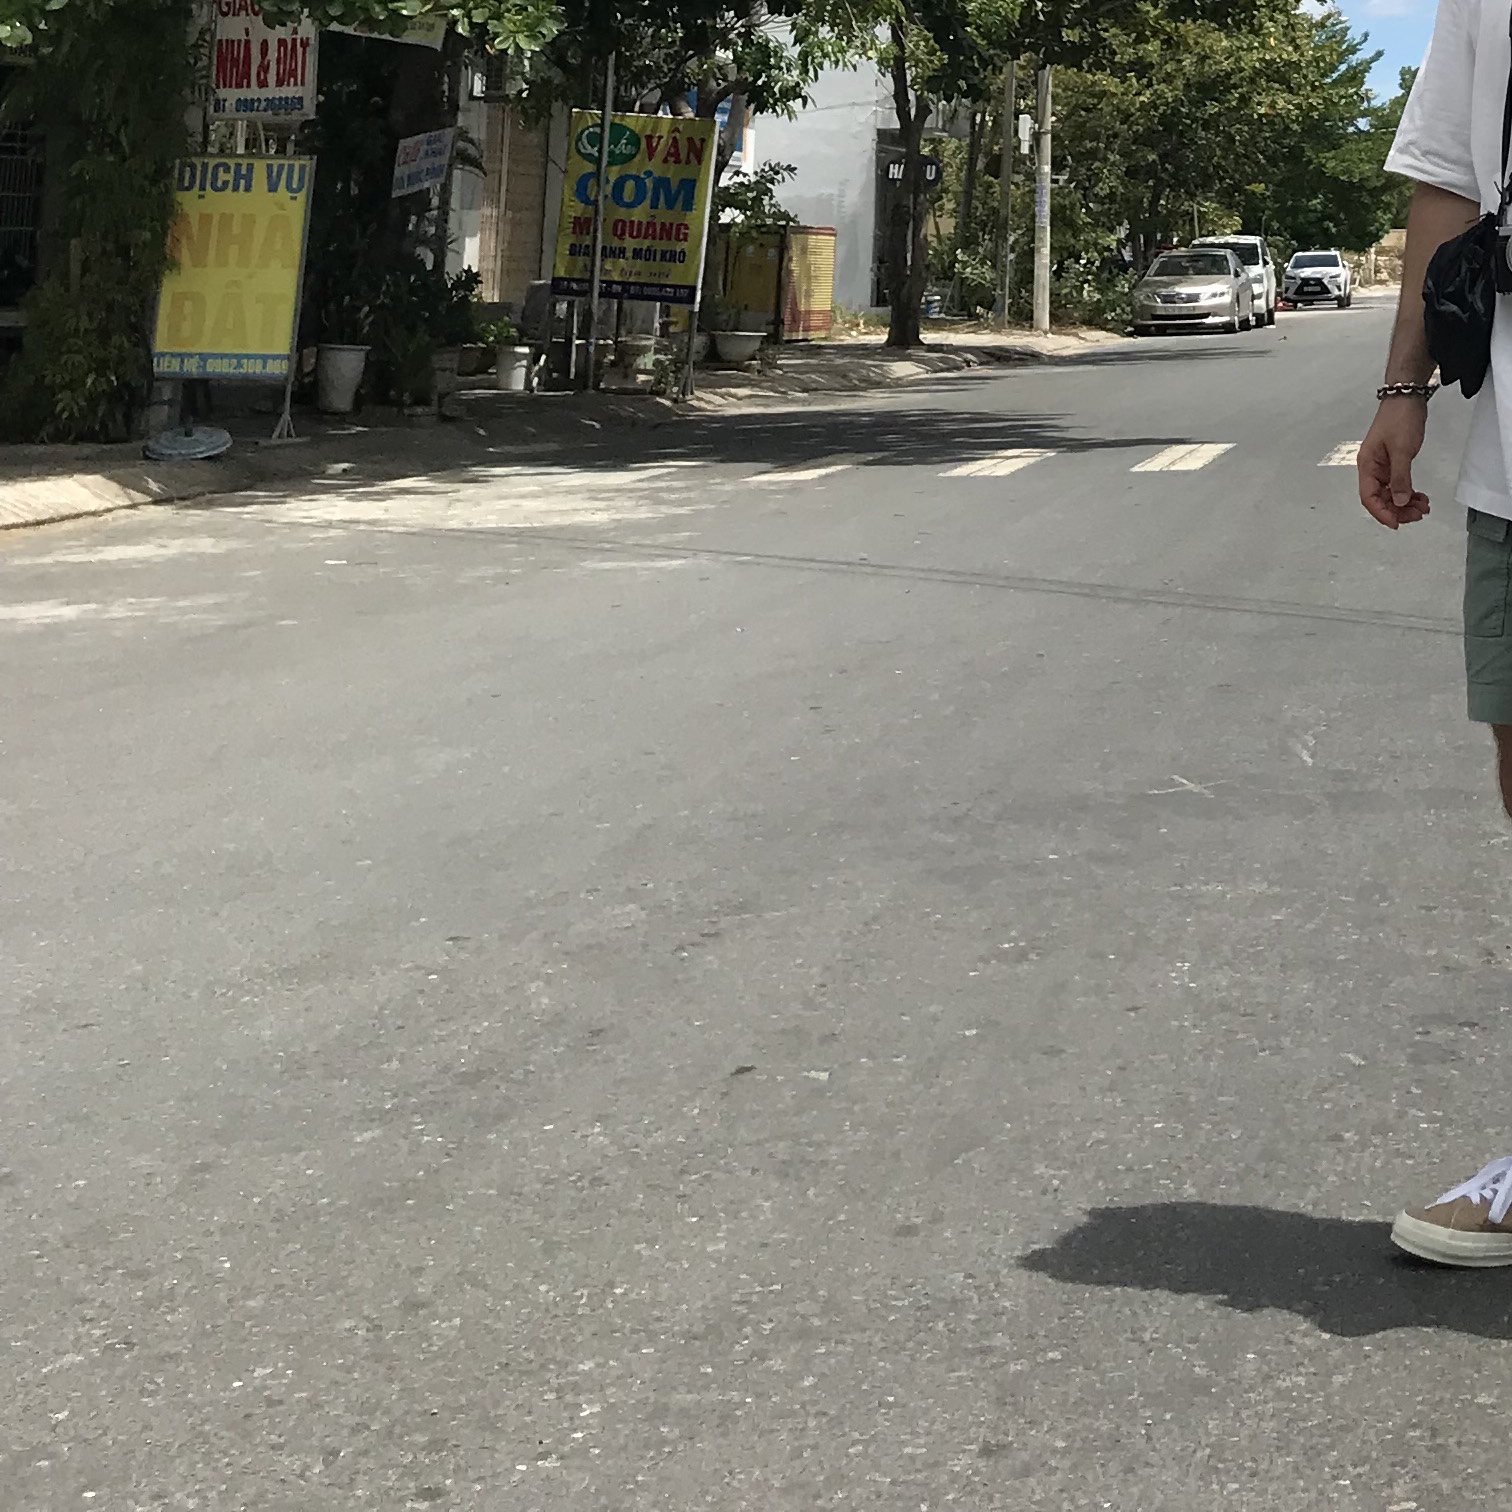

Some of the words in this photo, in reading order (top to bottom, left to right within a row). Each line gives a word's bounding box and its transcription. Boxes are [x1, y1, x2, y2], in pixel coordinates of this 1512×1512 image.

[214, 27, 252, 89] NHÀ
[256, 38, 271, 89] &
[644, 126, 706, 166] VÂN
[175, 160, 255, 199] DỊCH
[265, 162, 308, 201] VỤ
[575, 170, 698, 212] CƠM
[166, 201, 298, 269] NHÀ
[612, 216, 690, 242] QUẢNG
